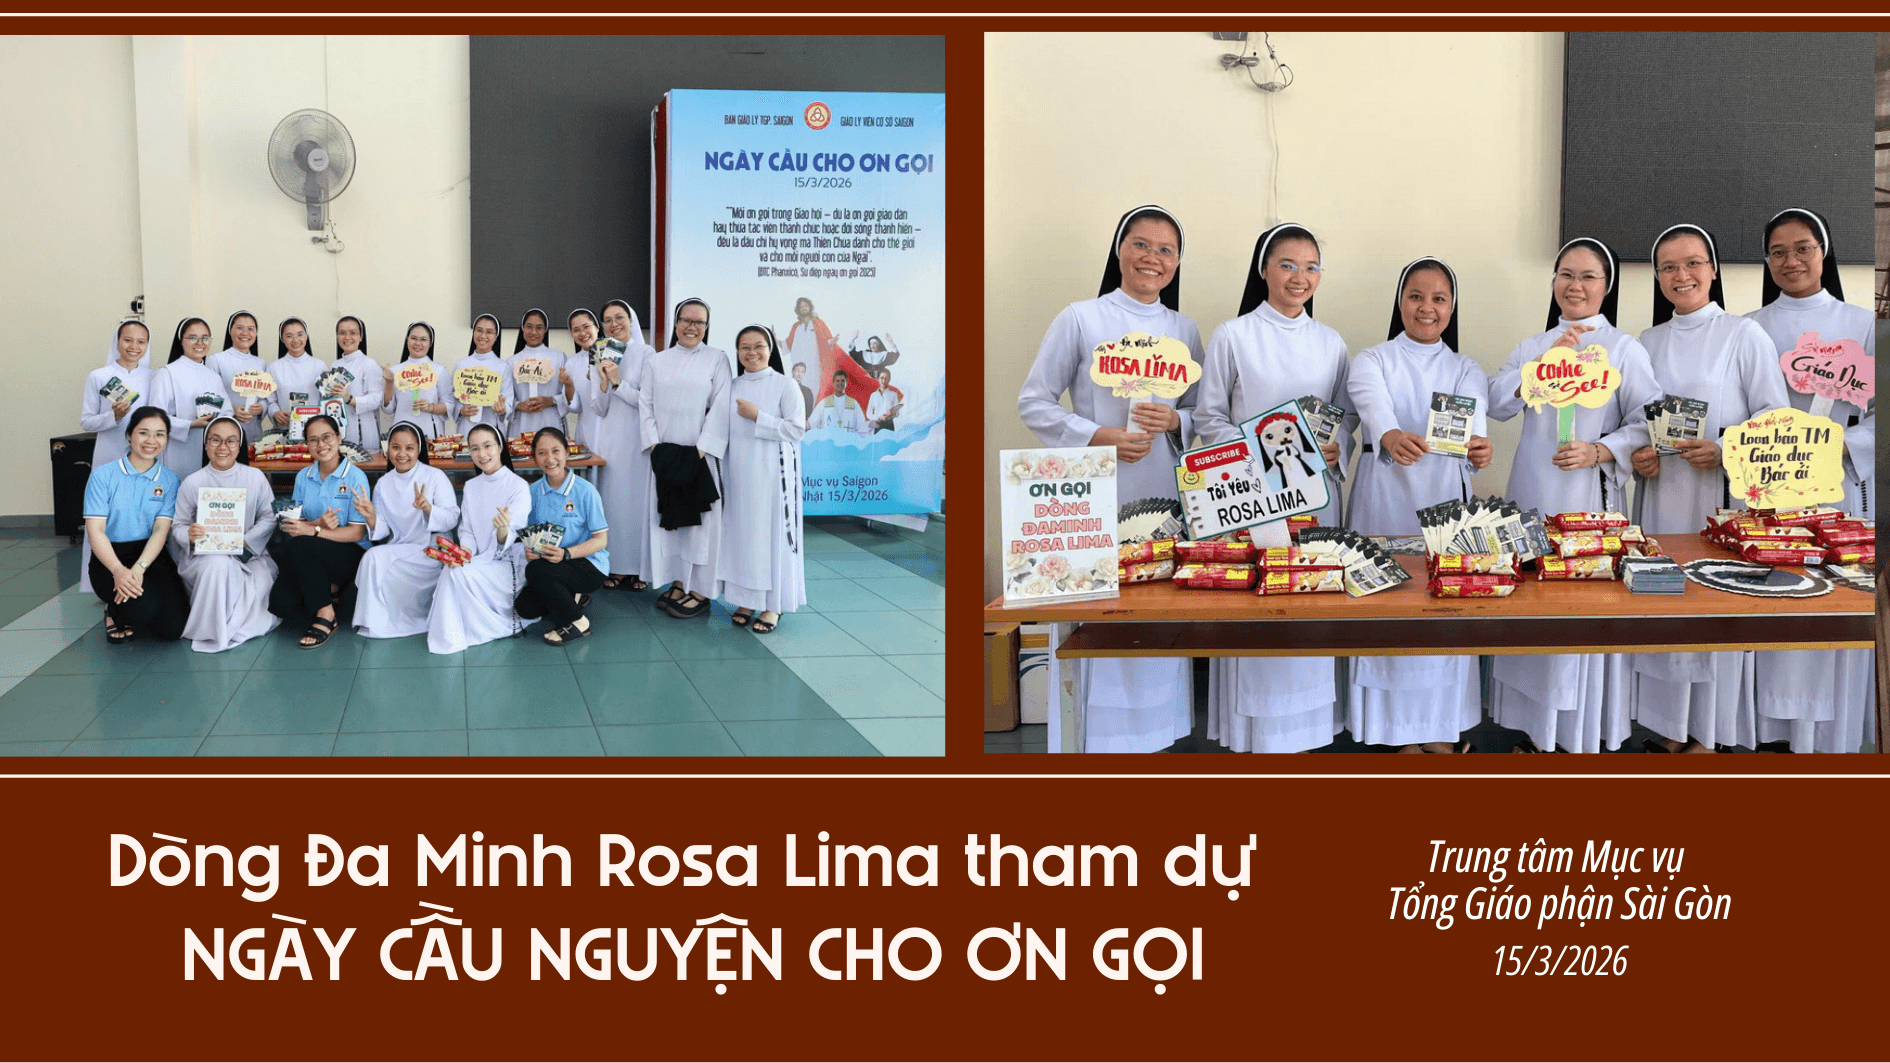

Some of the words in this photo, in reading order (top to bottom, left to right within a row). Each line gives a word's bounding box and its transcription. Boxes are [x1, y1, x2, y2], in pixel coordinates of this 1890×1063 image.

[724, 114, 736, 125] BAN
[704, 149, 764, 171] NGÀY
[812, 152, 855, 173] CHO
[859, 153, 891, 173] ƠN
[895, 153, 934, 175] GỌI
[794, 177, 852, 189] 15/3/2026
[771, 208, 792, 221] trong
[713, 221, 727, 235] hay
[872, 237, 885, 249] cho
[770, 250, 783, 262] cho
[821, 252, 835, 262] con
[1099, 355, 1141, 377] ROSA
[1791, 355, 1835, 379] Giáo
[1833, 364, 1871, 391] Dục
[1550, 370, 1609, 404] See!
[1740, 432, 1770, 446] Loan
[1774, 426, 1799, 445] báo
[1800, 427, 1831, 444] TM
[1194, 448, 1241, 467] SUBSCRIBE
[1749, 445, 1781, 463] Giáo
[1786, 445, 1814, 465] dục
[826, 478, 840, 489] vụ
[842, 475, 879, 489] Saigon
[1760, 463, 1790, 485] Bác
[1794, 463, 1810, 480] ái
[829, 489, 889, 503] 15/3/2026
[1029, 483, 1057, 498] ƠN
[1060, 481, 1092, 499] GỌI
[1206, 482, 1227, 502] Tôi
[1227, 477, 1250, 497] Yêu
[221, 502, 236, 510] GỌI
[1034, 497, 1091, 518] DÒNG
[1217, 499, 1266, 528] ROSA
[1265, 488, 1308, 515] LIMA
[1021, 517, 1102, 536] ĐAMINH
[1011, 537, 1065, 555] ROSA
[1067, 534, 1114, 551] LIMA
